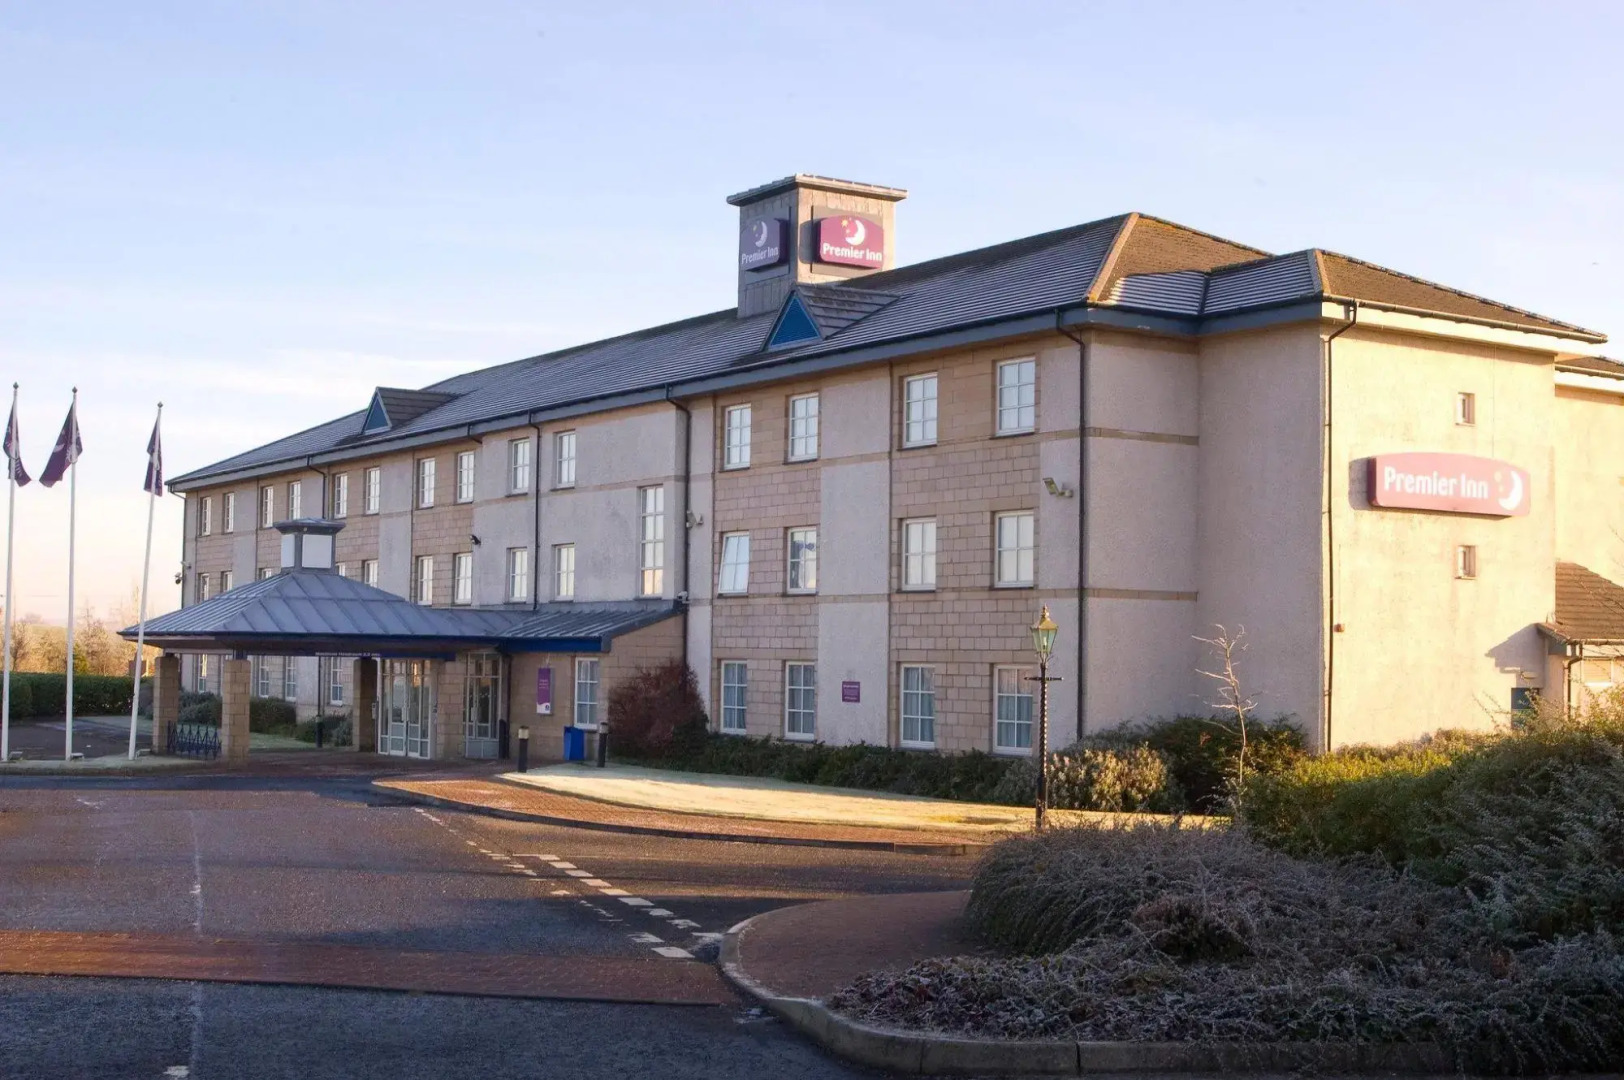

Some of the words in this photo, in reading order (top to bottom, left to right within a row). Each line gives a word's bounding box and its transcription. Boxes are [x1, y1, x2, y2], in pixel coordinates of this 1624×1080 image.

[741, 248, 766, 265] Premier
[767, 246, 779, 258] Inn
[822, 242, 863, 259] Premier
[866, 248, 882, 261] Inn
[1384, 466, 1457, 496] Premier
[1461, 473, 1489, 499] Inn
